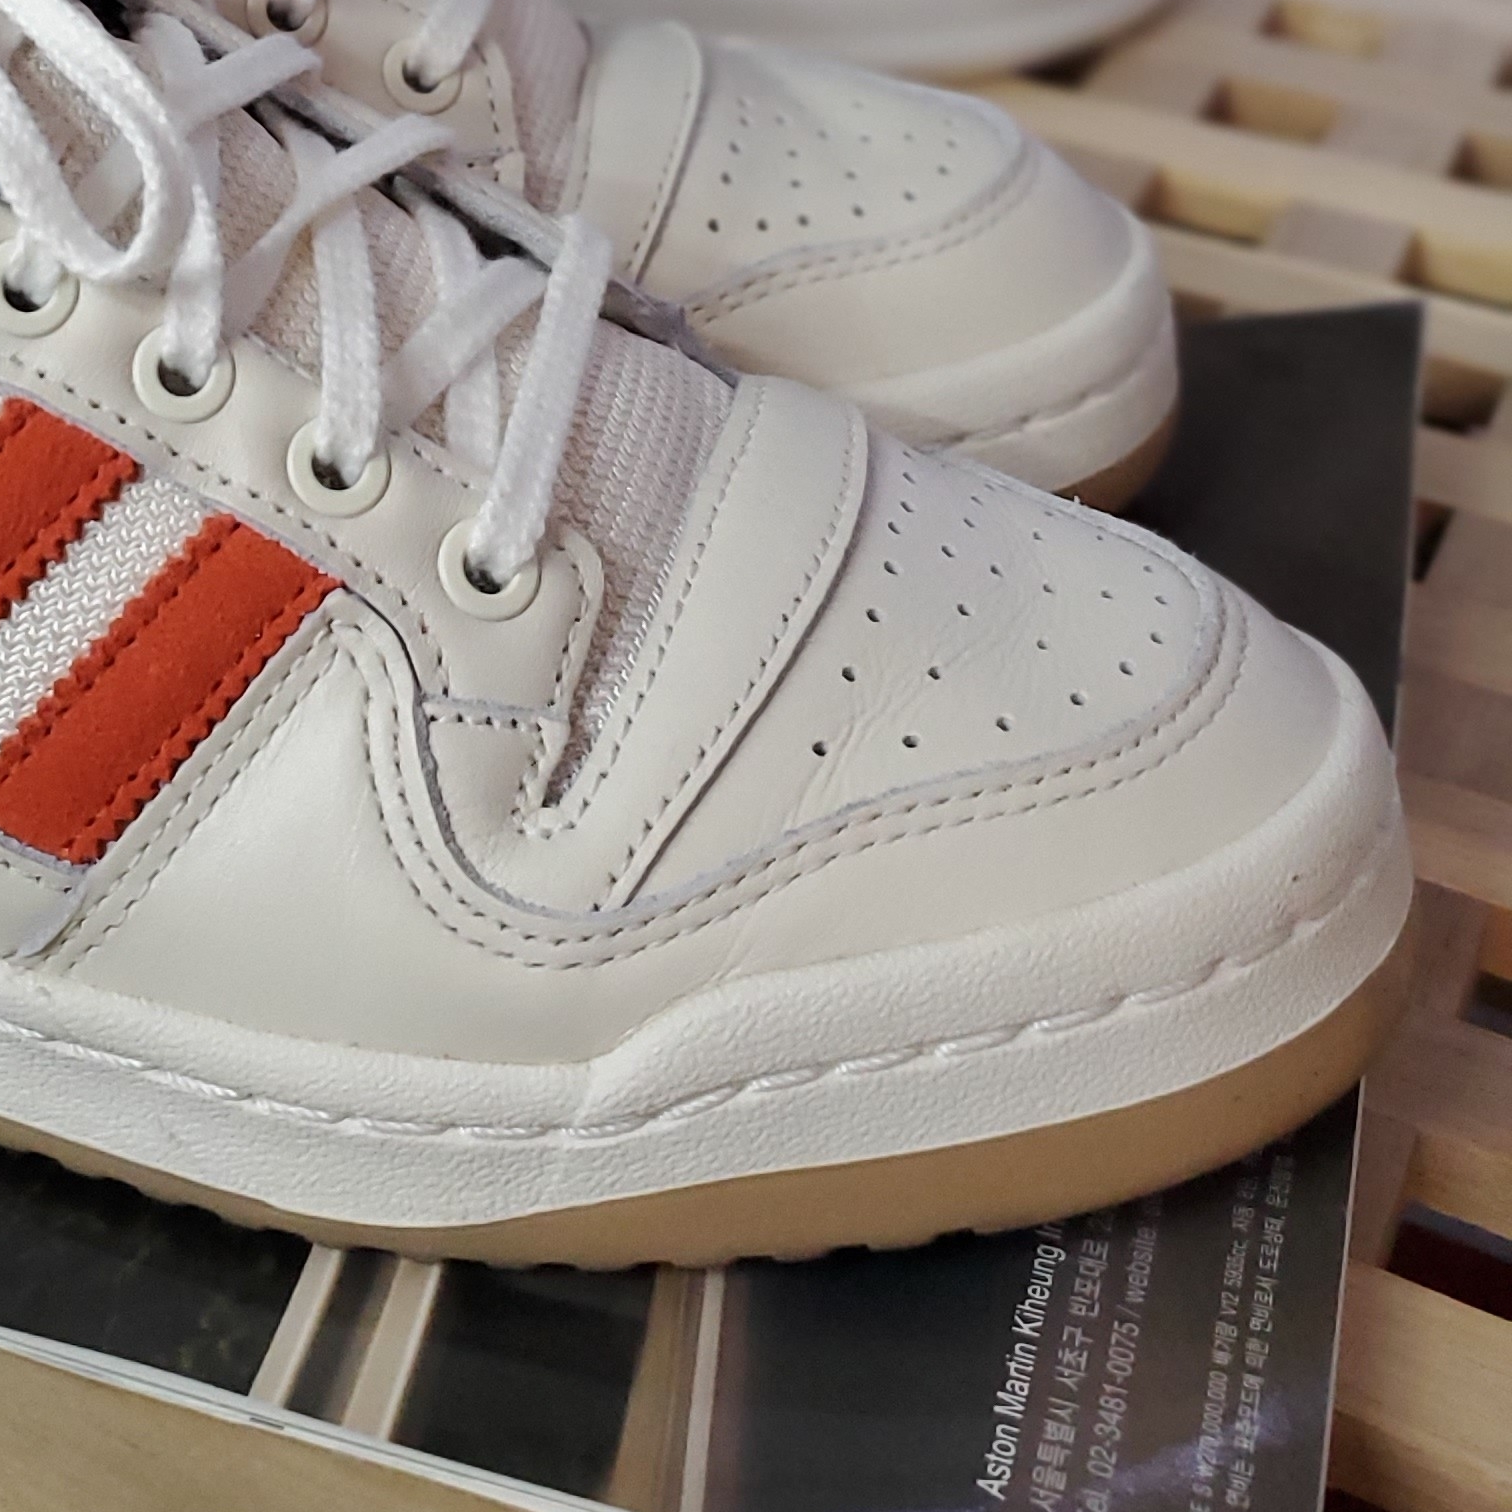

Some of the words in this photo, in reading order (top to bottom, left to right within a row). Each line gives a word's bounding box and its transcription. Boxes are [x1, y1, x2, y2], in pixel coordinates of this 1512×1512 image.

[1011, 1243, 1067, 1337] Kiheung
[1068, 1239, 1109, 1317] 반포대로
[1219, 1291, 1240, 1315] V12
[993, 1341, 1038, 1419] Martin
[1055, 1325, 1094, 1391] 서초구
[1087, 1320, 1140, 1478] 02-3481-0075
[976, 1423, 1022, 1501] Aston
[1029, 1396, 1081, 1512] 서울특별시
